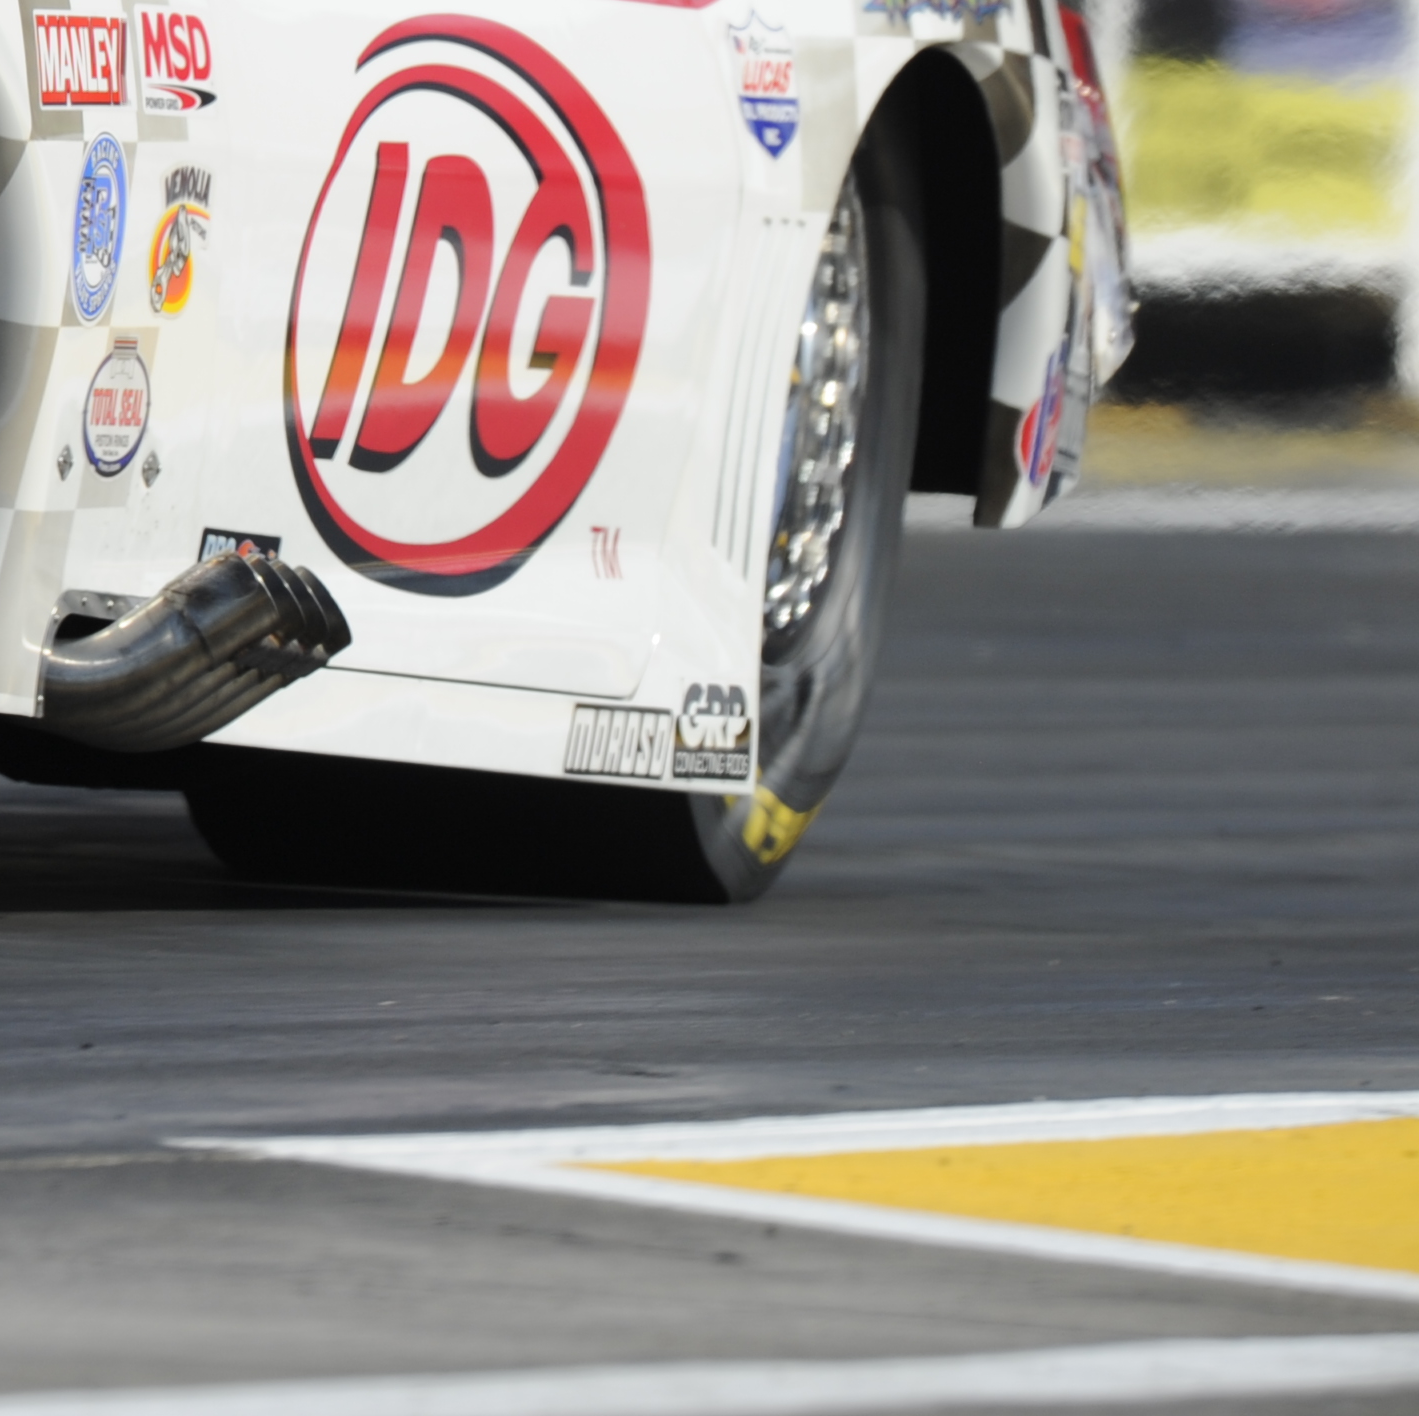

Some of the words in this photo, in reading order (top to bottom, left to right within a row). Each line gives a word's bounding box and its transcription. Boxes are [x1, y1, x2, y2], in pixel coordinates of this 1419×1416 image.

[36, 17, 121, 102] MANLEY
[140, 10, 212, 83] MSD
[742, 59, 793, 95] LUCAS
[307, 140, 597, 479] IDG
[90, 387, 119, 427] TOTAL
[118, 388, 144, 427] SEAL
[590, 526, 624, 581] TM
[564, 703, 674, 780] MOROSO
[679, 682, 750, 750] GRP
